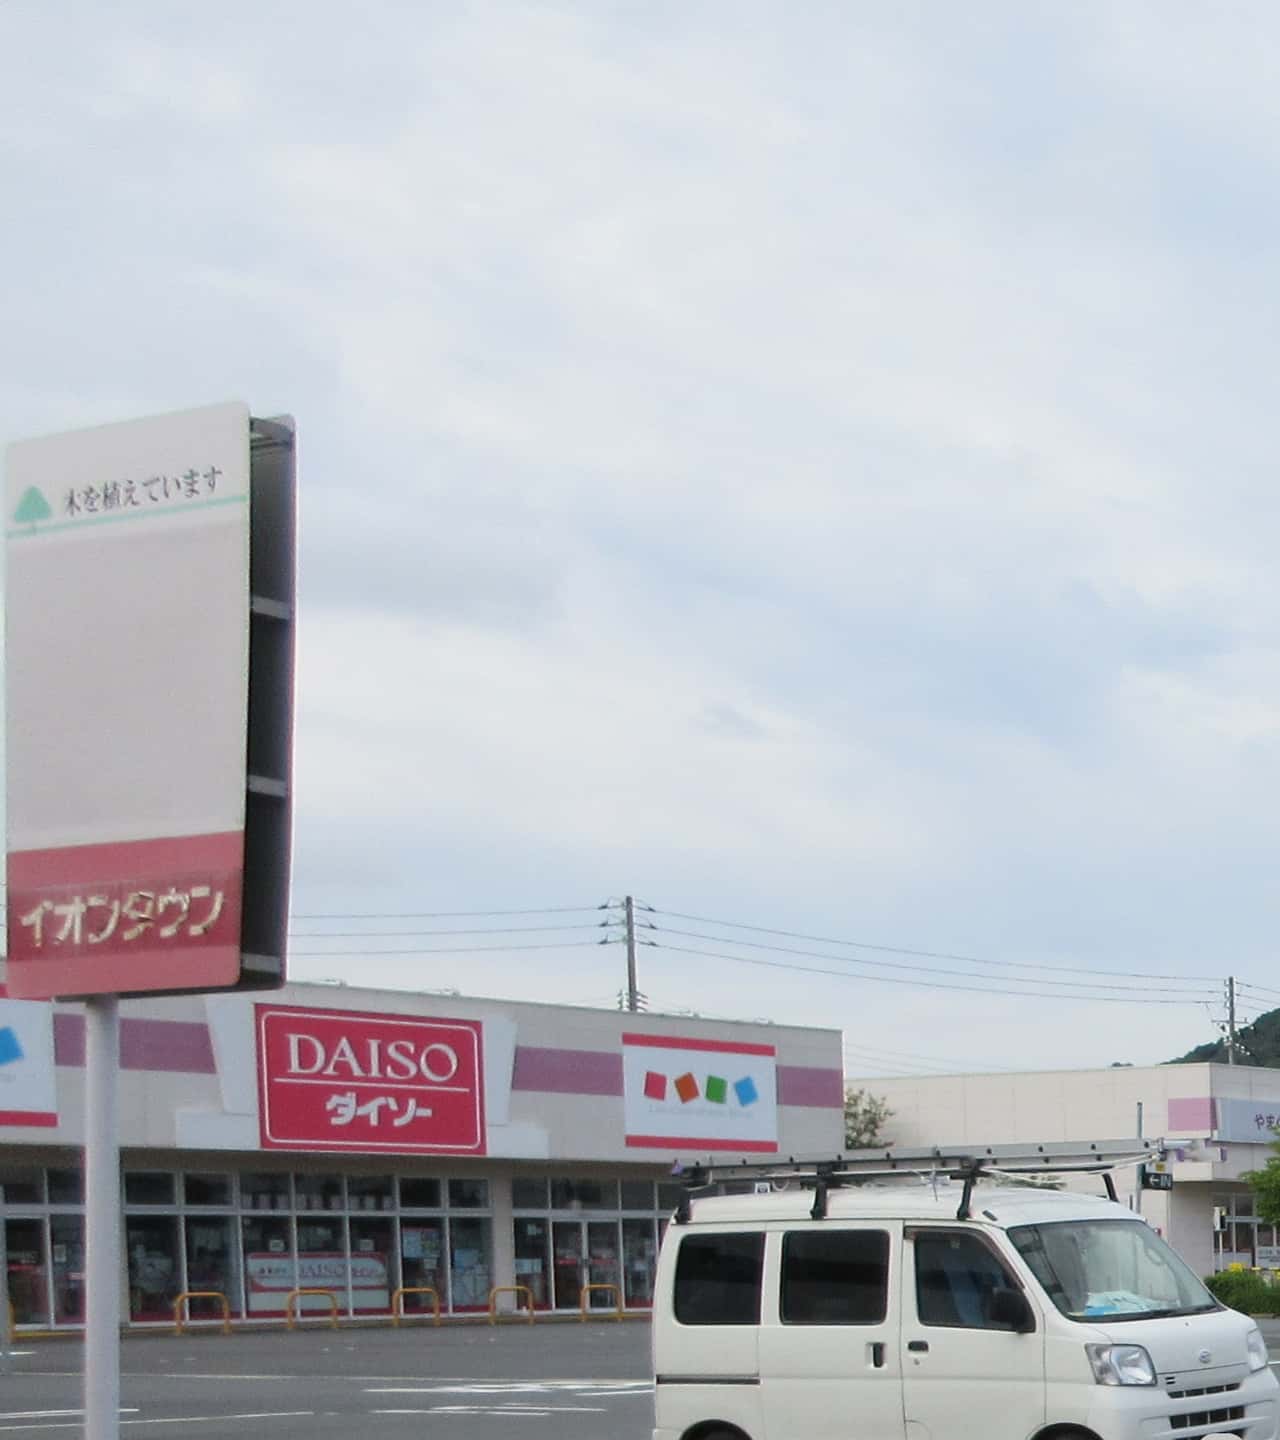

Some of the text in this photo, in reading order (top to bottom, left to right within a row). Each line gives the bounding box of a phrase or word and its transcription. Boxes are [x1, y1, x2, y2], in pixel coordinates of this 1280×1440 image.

[21, 887, 223, 946] イオンタウン
[286, 1033, 458, 1082] DAISO
[325, 1091, 433, 1127] ダイソー
